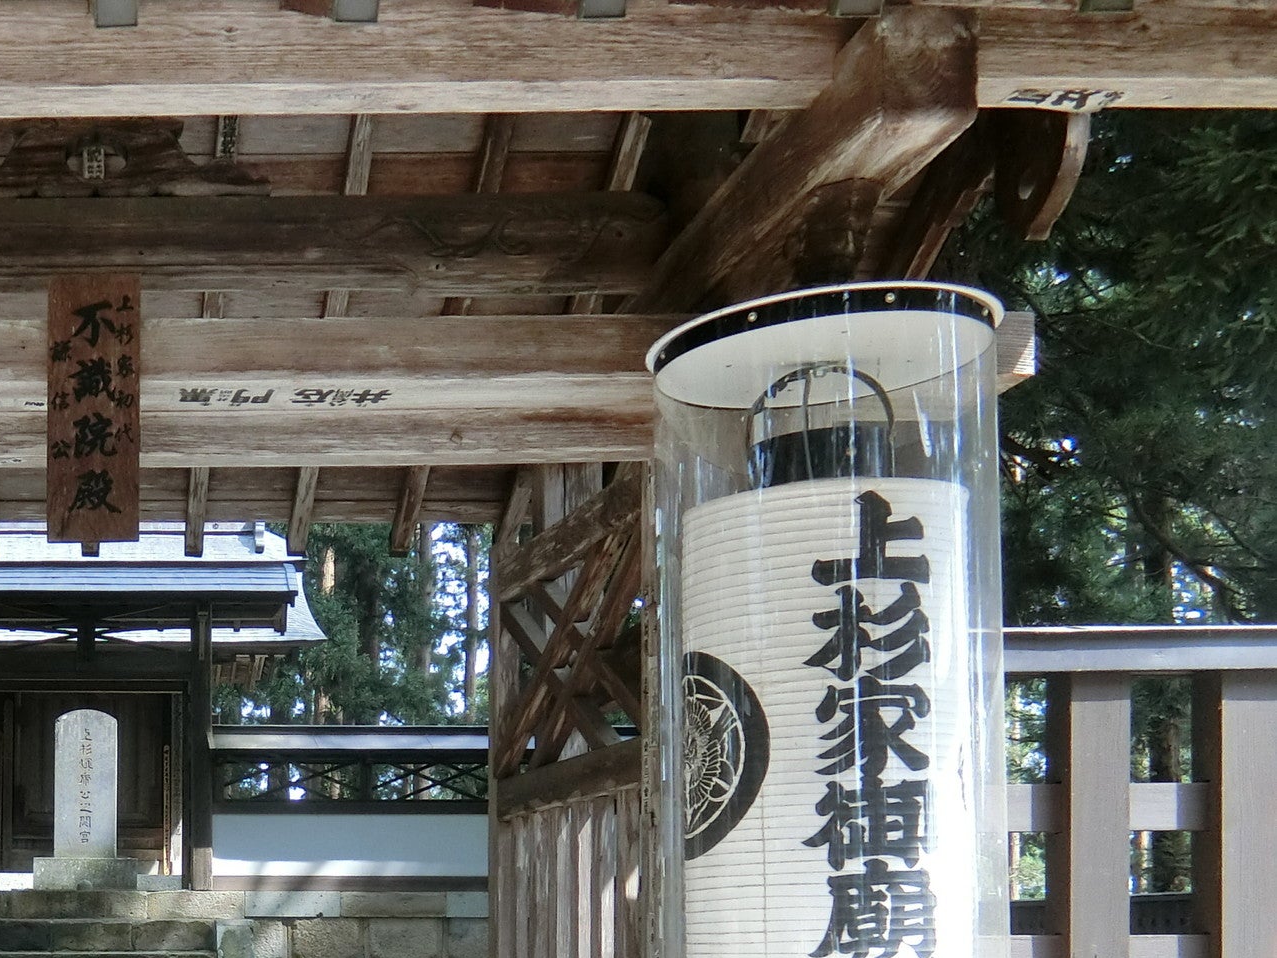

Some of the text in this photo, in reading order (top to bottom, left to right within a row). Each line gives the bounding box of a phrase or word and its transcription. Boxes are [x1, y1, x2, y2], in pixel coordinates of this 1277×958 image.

[112, 294, 136, 444] 上杉家初代
